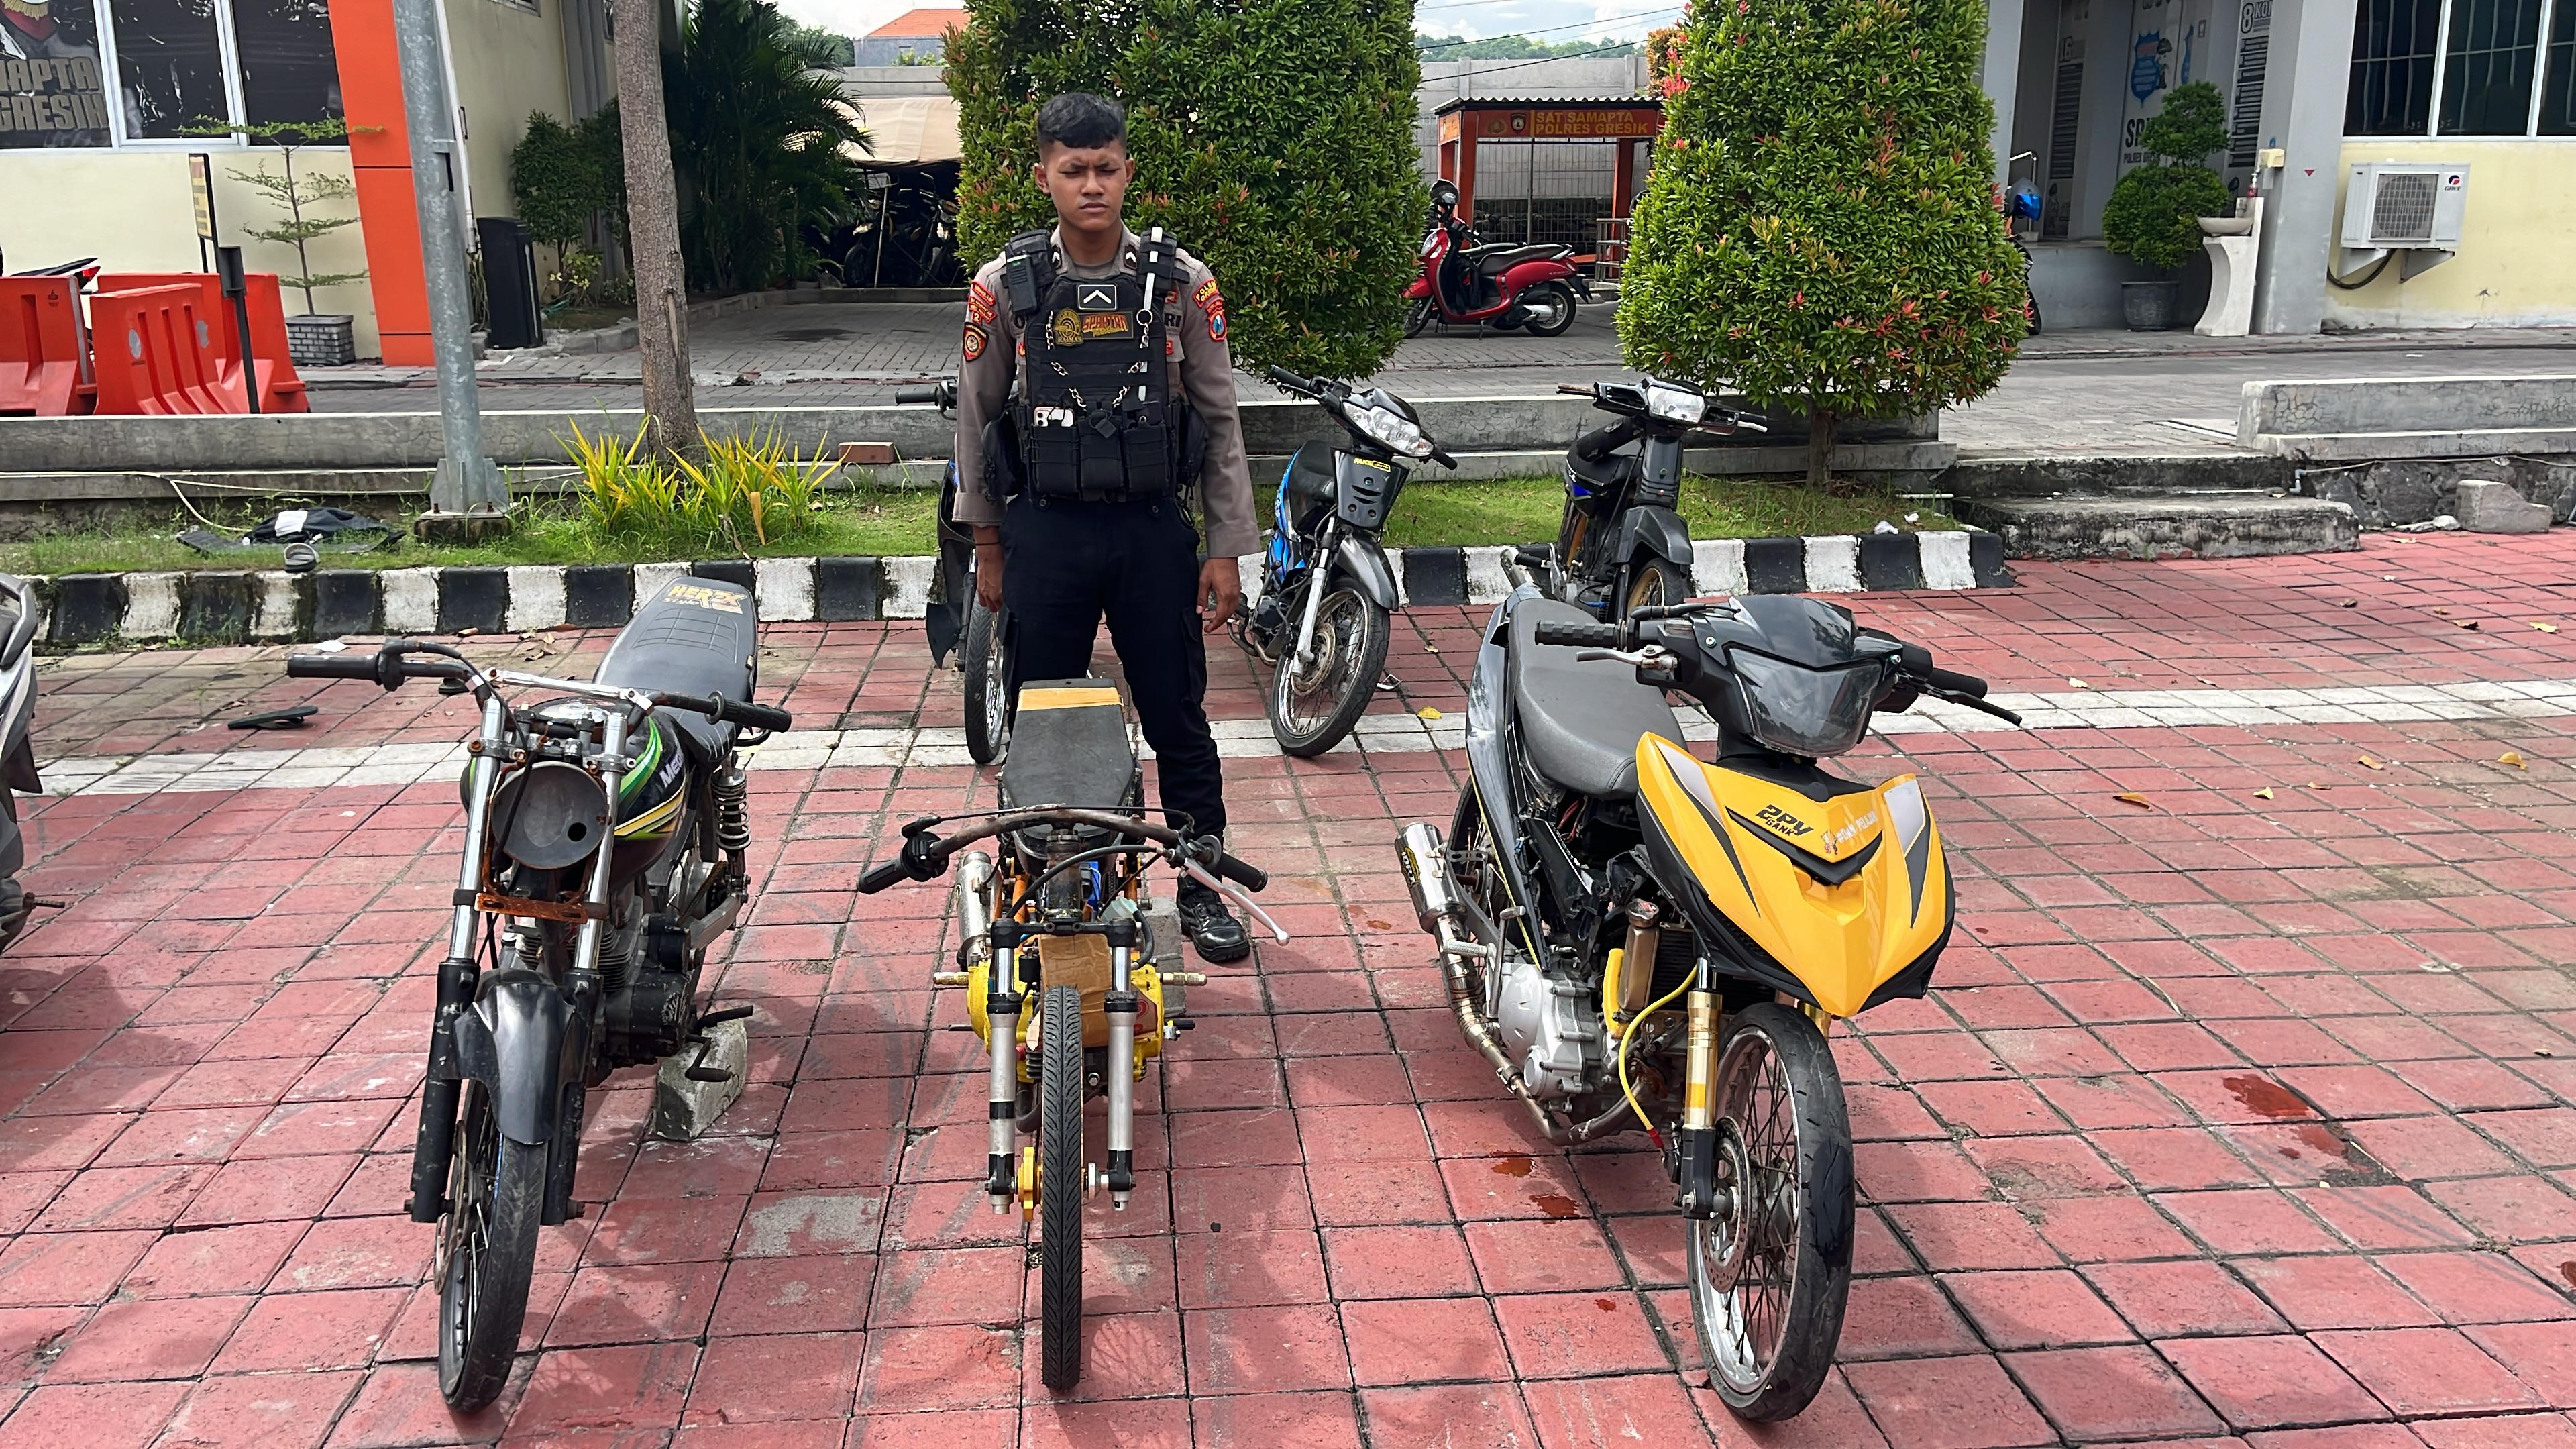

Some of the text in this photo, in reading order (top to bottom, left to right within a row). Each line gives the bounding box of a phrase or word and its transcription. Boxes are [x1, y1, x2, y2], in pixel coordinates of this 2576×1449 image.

[2241, 3, 2254, 33] 8
[1536, 111, 1634, 123] SAT SAMAPTA
[1536, 123, 1648, 134] POLRES GRESIK
[667, 584, 747, 614] HEREX
[1756, 804, 1814, 836] 2PV
[1766, 817, 1796, 837] GANK
